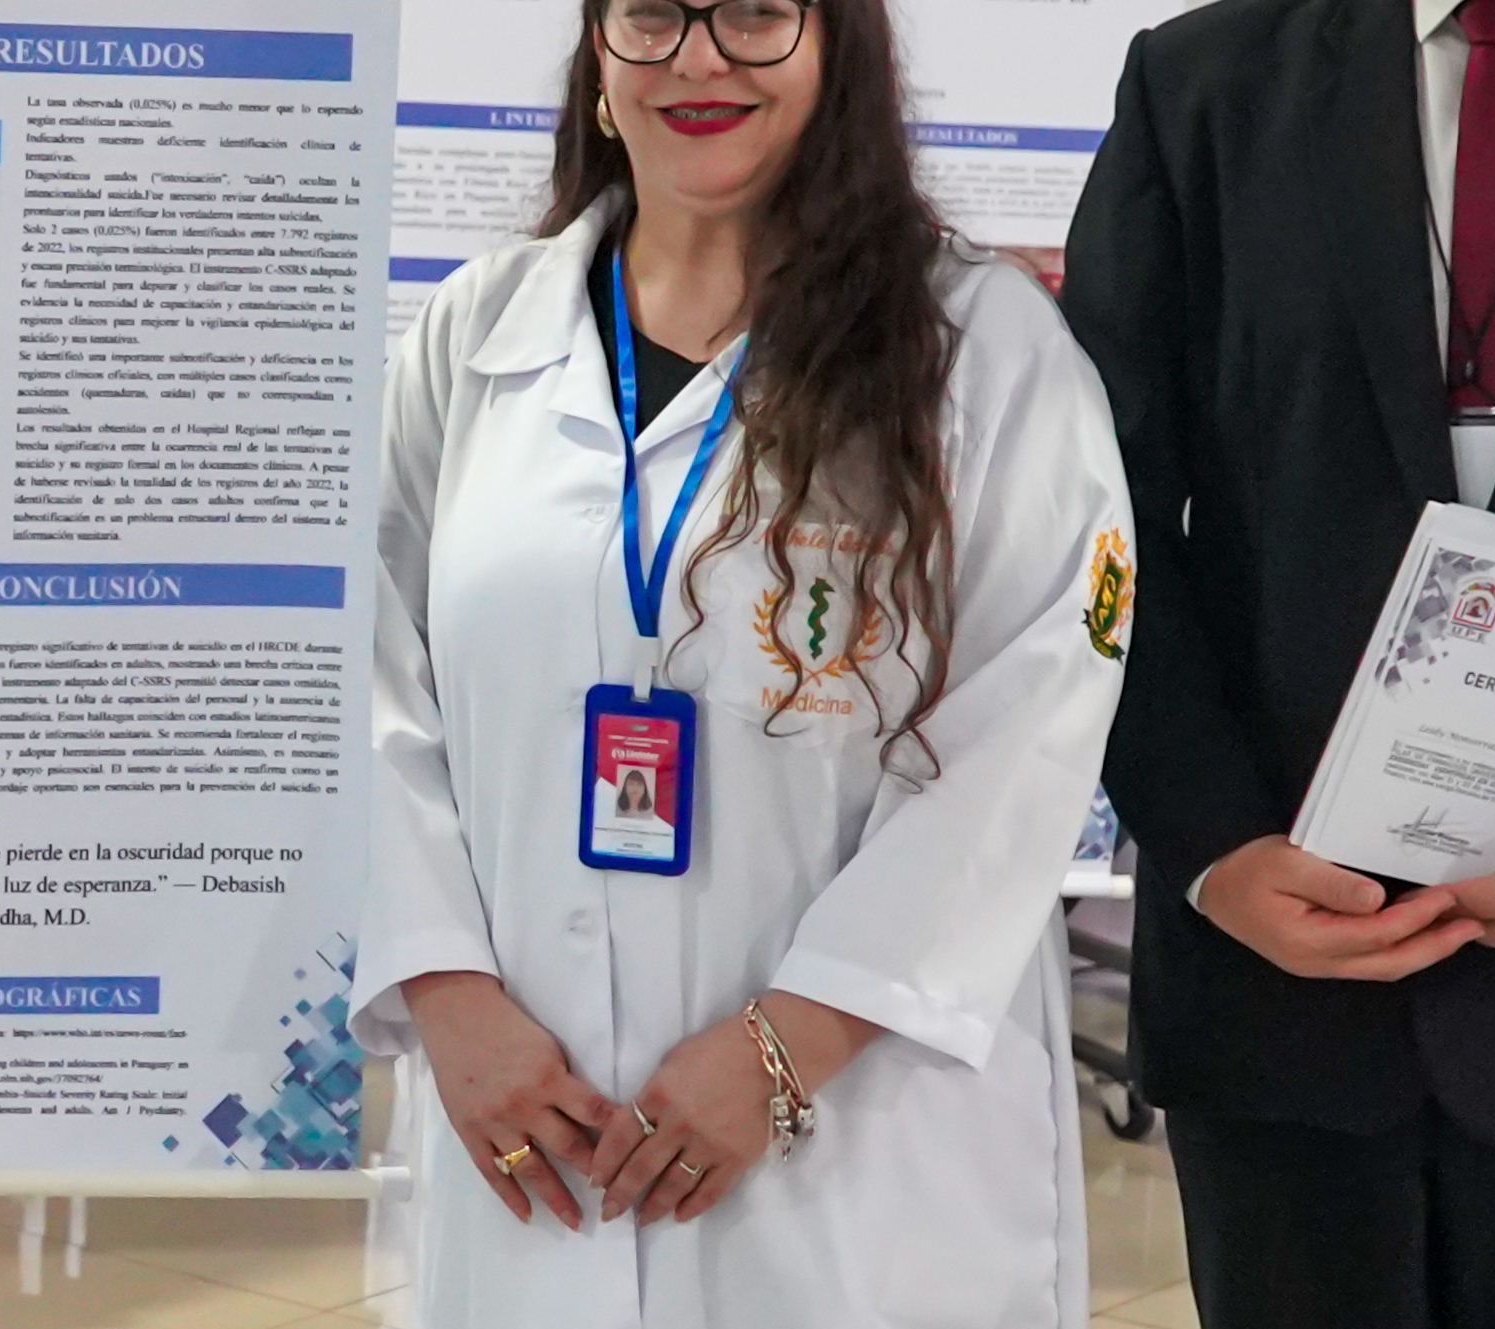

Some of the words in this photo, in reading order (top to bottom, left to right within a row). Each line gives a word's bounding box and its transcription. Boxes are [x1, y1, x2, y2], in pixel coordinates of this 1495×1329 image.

[5, 843, 63, 866] pierde
[68, 848, 90, 861] en
[96, 842, 112, 861] la
[117, 842, 205, 861] oscuridad
[210, 847, 274, 865] porque
[279, 848, 303, 862] no
[3, 875, 32, 894] luz
[36, 875, 58, 894] de
[201, 875, 286, 894] Debasish
[42, 906, 92, 928] M.D.
